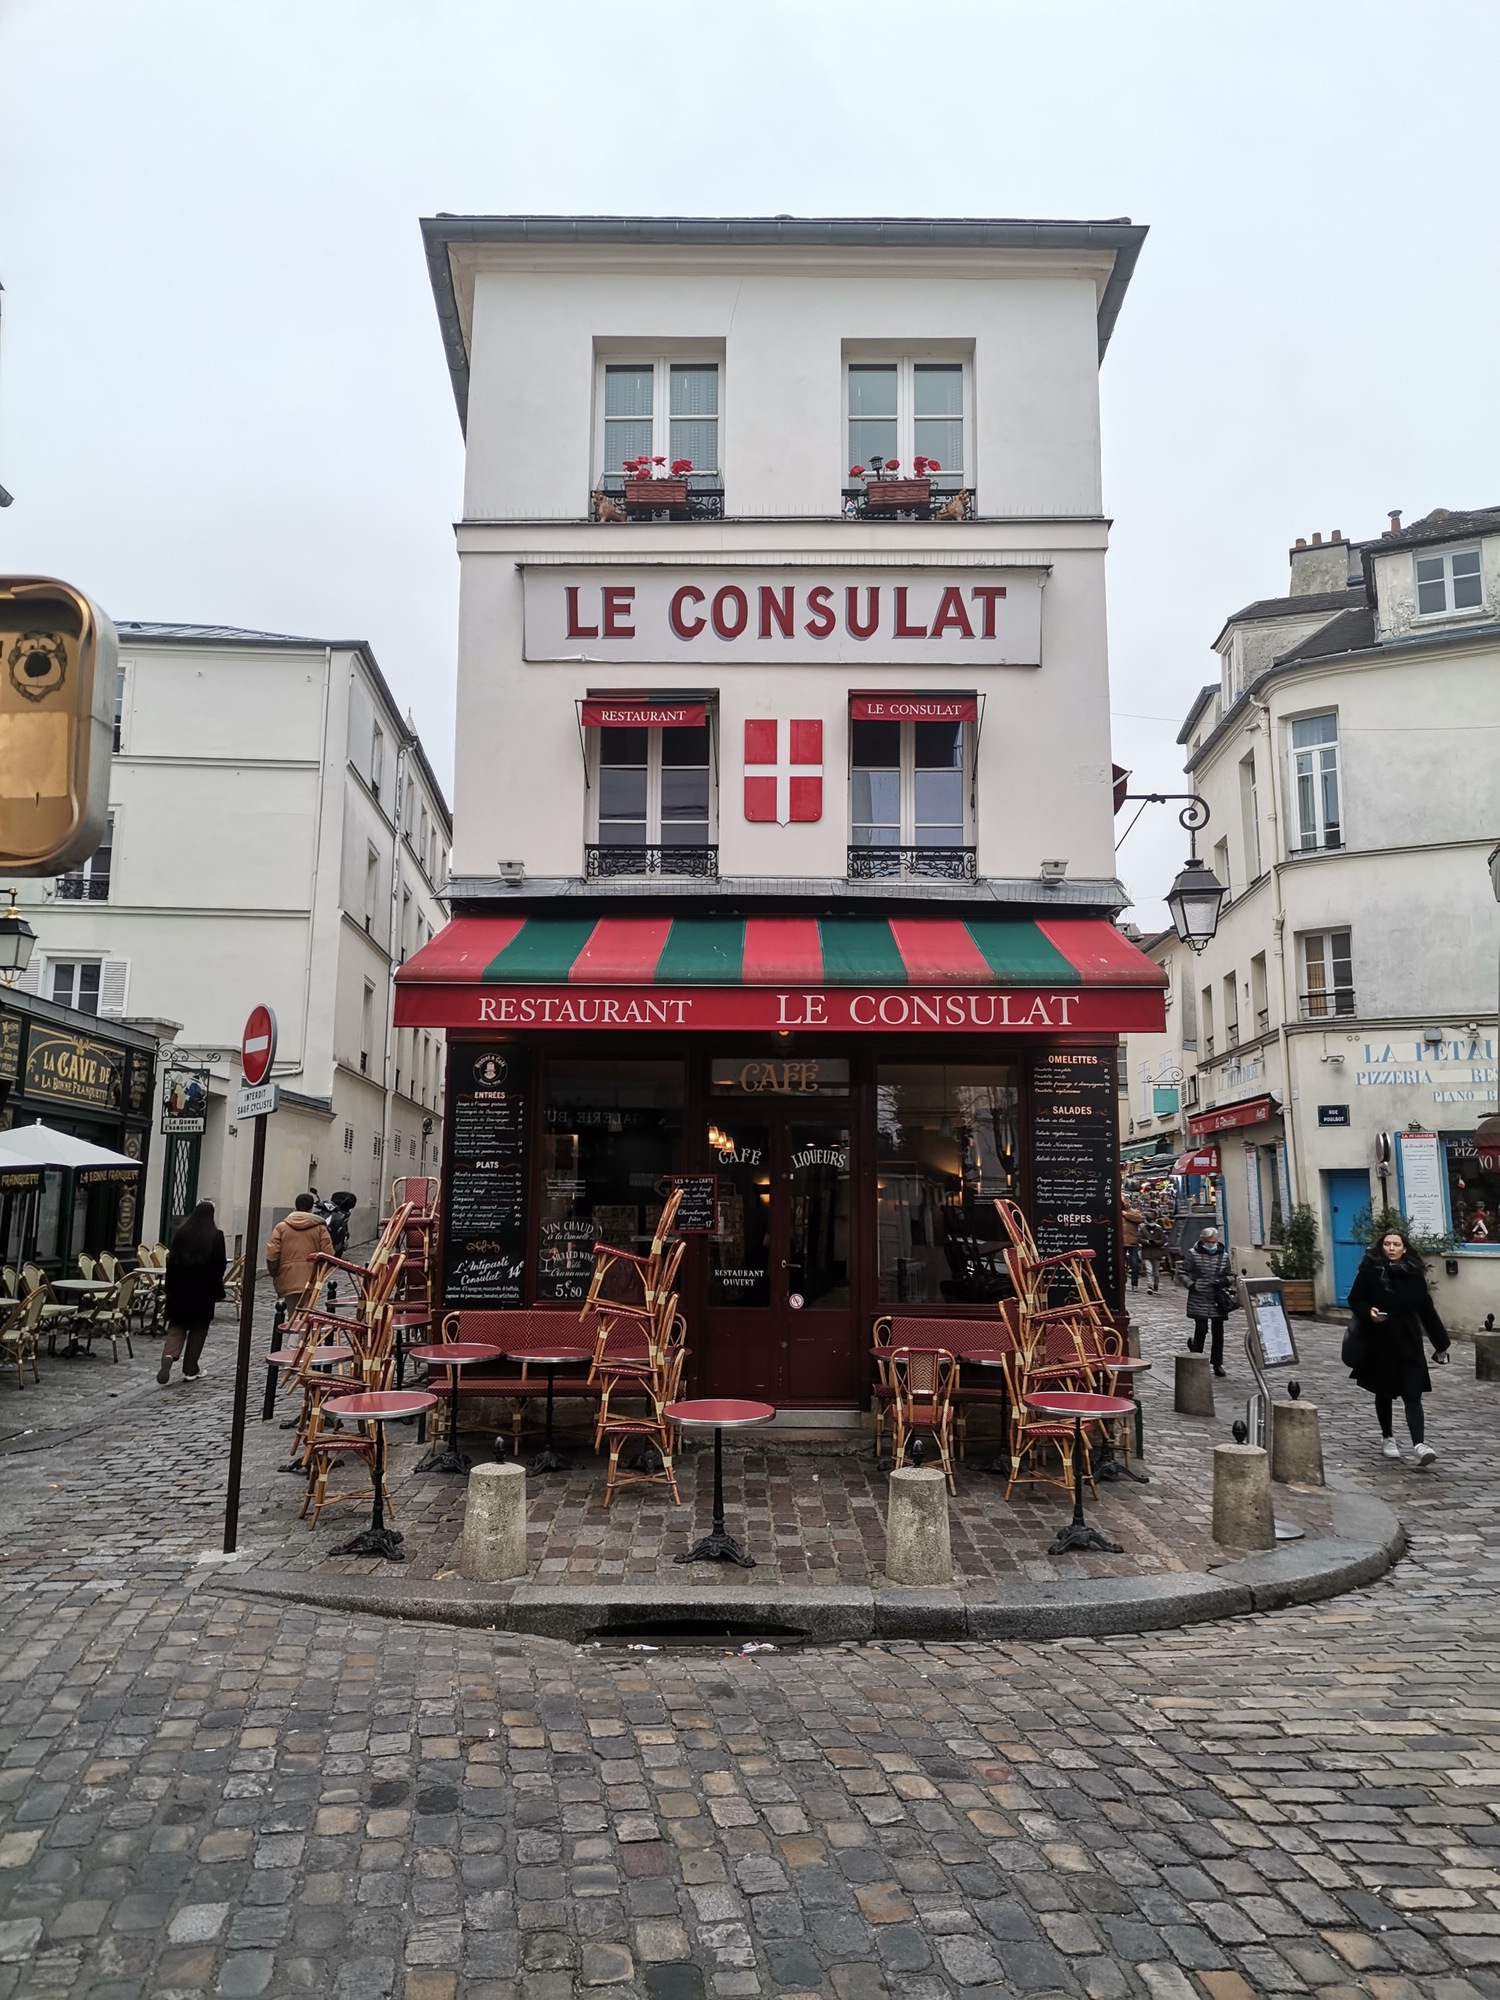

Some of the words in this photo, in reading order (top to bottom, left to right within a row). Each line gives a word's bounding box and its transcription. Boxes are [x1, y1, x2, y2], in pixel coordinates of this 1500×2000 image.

[565, 585, 636, 640] LE
[668, 584, 1007, 642] CONSULAT
[601, 710, 686, 722] RESTAURANT
[867, 703, 884, 715] LE
[890, 703, 962, 716] CONSULAT
[478, 997, 692, 1024] RESTAURANT
[776, 995, 829, 1025] LE
[849, 995, 1079, 1026] CONSULAT
[1048, 1055, 1098, 1064] OMELETTES
[1364, 1043, 1398, 1064] LA
[43, 1051, 54, 1071] LA
[57, 1051, 97, 1084] CAVE
[99, 1066, 111, 1084] DE
[41, 1074, 51, 1088] LA
[740, 1059, 819, 1093] CAFÉ
[1356, 1070, 1433, 1085] PIZZERIA
[244, 1089, 266, 1102] INTERDIT
[474, 1091, 506, 1099] ENTRÉES
[1433, 1091, 1475, 1102] PIANO
[237, 1105, 249, 1115] SAUF
[250, 1099, 272, 1112] CYCLISTE
[1052, 1106, 1092, 1115] SALADES
[1446, 1138, 1458, 1147] La
[718, 1148, 762, 1166] CAFÉ
[790, 1149, 846, 1169] LIQUEURS
[476, 1161, 499, 1169] PLATS
[1057, 1213, 1092, 1223] CRÊPES
[541, 1222, 561, 1235] VIN
[563, 1220, 594, 1234] CHAUD
[555, 1232, 563, 1240] la
[579, 1250, 596, 1263] WINE
[453, 1256, 510, 1275] L'Antipasti
[550, 1267, 590, 1277] Cinnamon
[461, 1270, 502, 1285] Consulat
[715, 1269, 764, 1277] RESTAURANT
[722, 1278, 755, 1287] OUVERT
